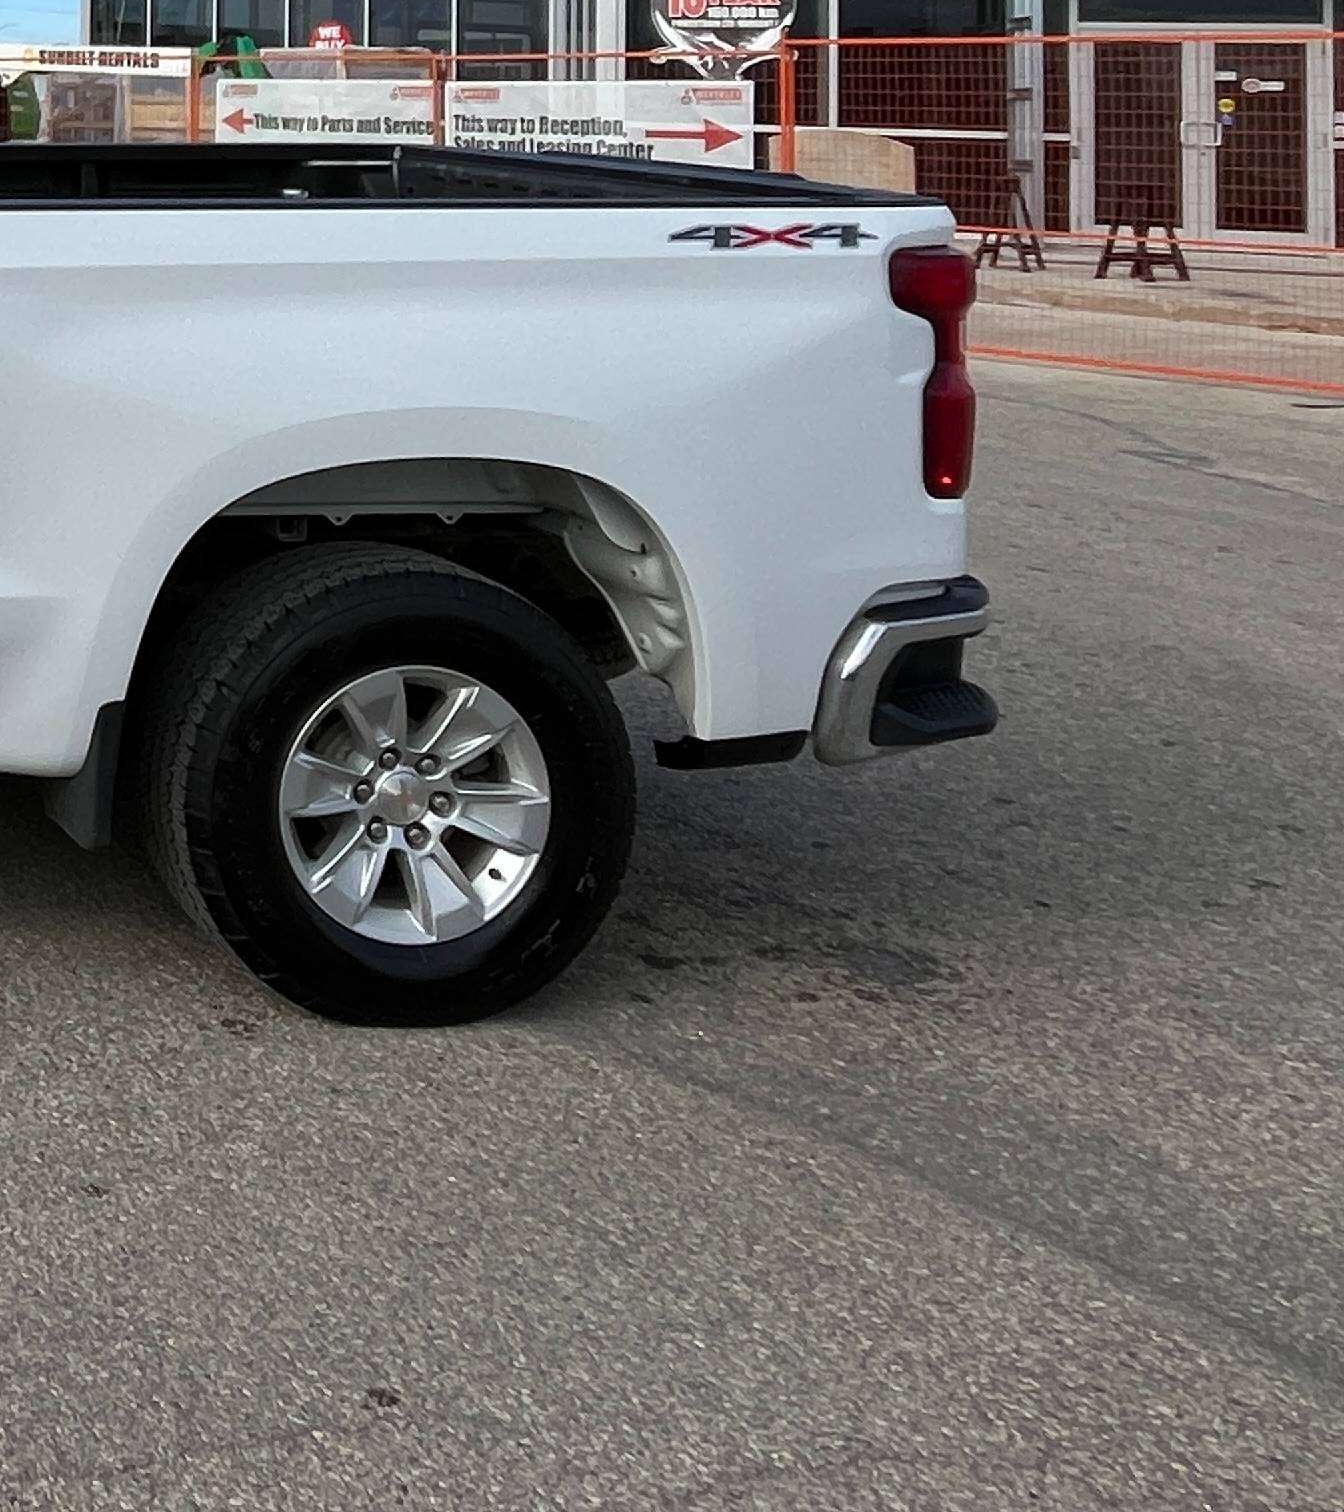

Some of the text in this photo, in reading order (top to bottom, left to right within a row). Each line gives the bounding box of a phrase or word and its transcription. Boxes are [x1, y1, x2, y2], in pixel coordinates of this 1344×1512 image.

[318, 25, 342, 39] WE
[255, 113, 280, 130] This
[282, 117, 304, 133] way
[321, 115, 354, 133] Parts
[356, 116, 381, 134] and
[384, 116, 434, 136] Service
[453, 114, 628, 138] This way to Reception,
[498, 137, 526, 152] and
[596, 139, 654, 160] Center
[667, 222, 880, 249] 4X4
